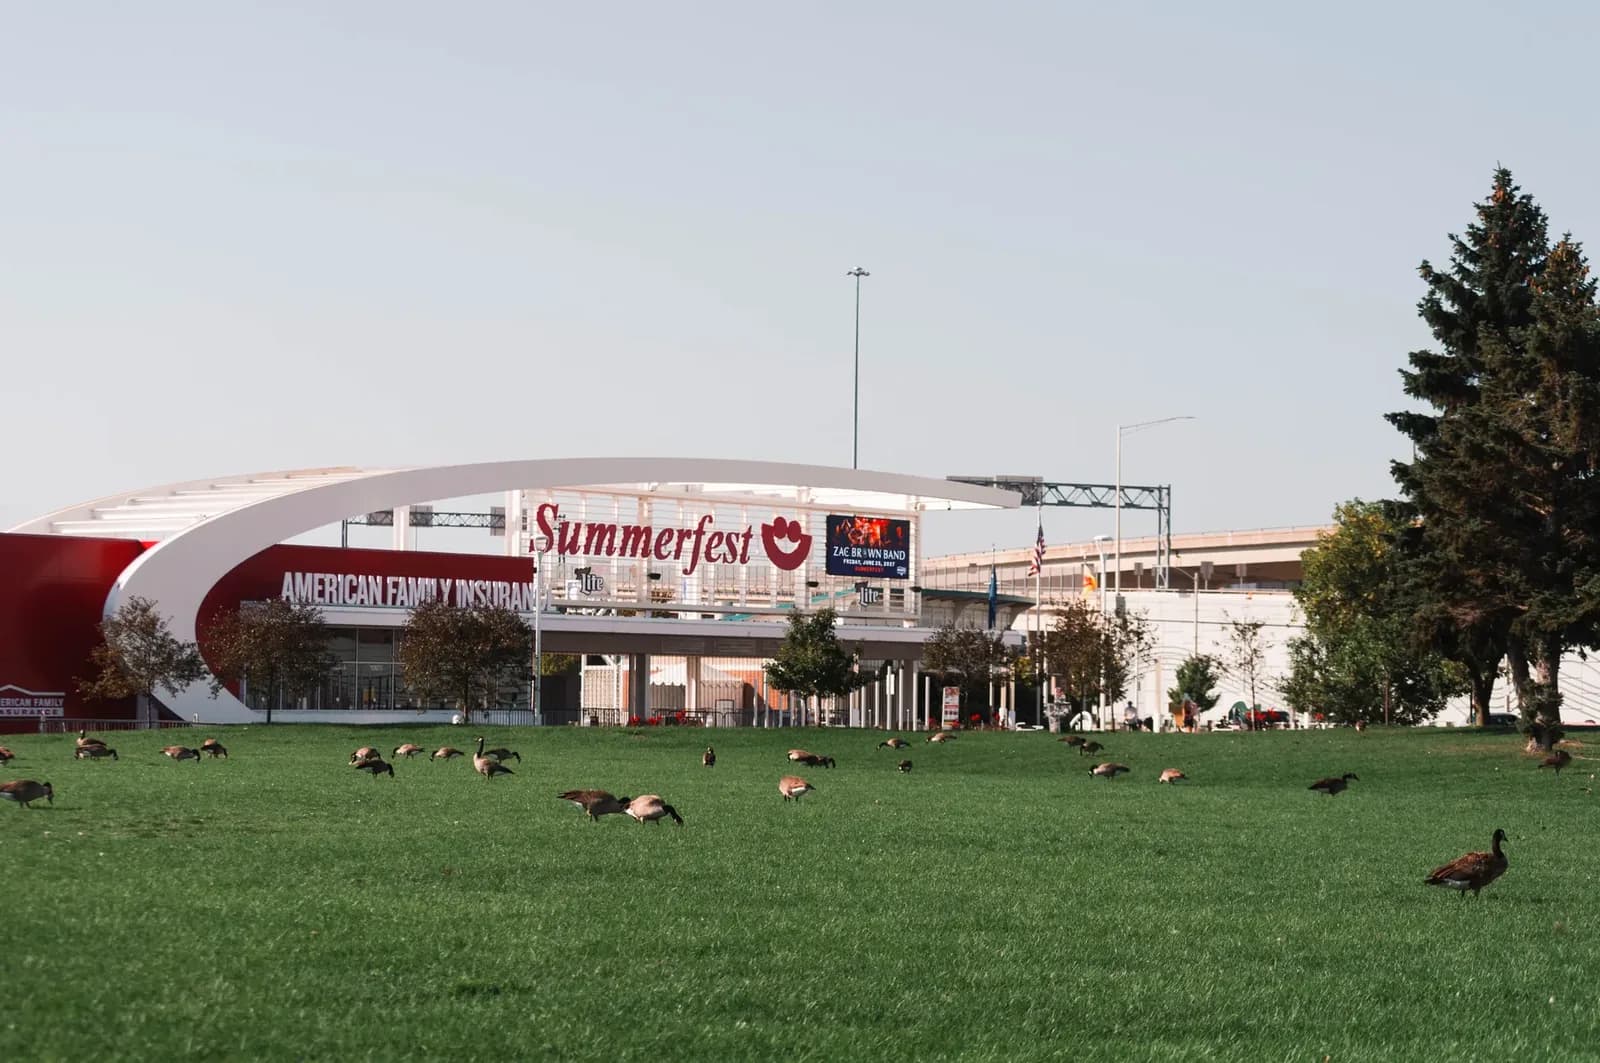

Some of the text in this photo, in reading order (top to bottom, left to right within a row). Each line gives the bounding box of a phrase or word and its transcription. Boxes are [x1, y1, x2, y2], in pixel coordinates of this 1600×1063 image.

[529, 503, 753, 575] Summerfest
[833, 546, 849, 557] ZAC
[883, 549, 906, 560] BAND
[281, 571, 383, 606] AMERICAN
[386, 576, 453, 607] FAMILY
[580, 573, 604, 595] Lite
[859, 587, 879, 606] Lite
[0, 698, 64, 707] ERICAN FAMILY
